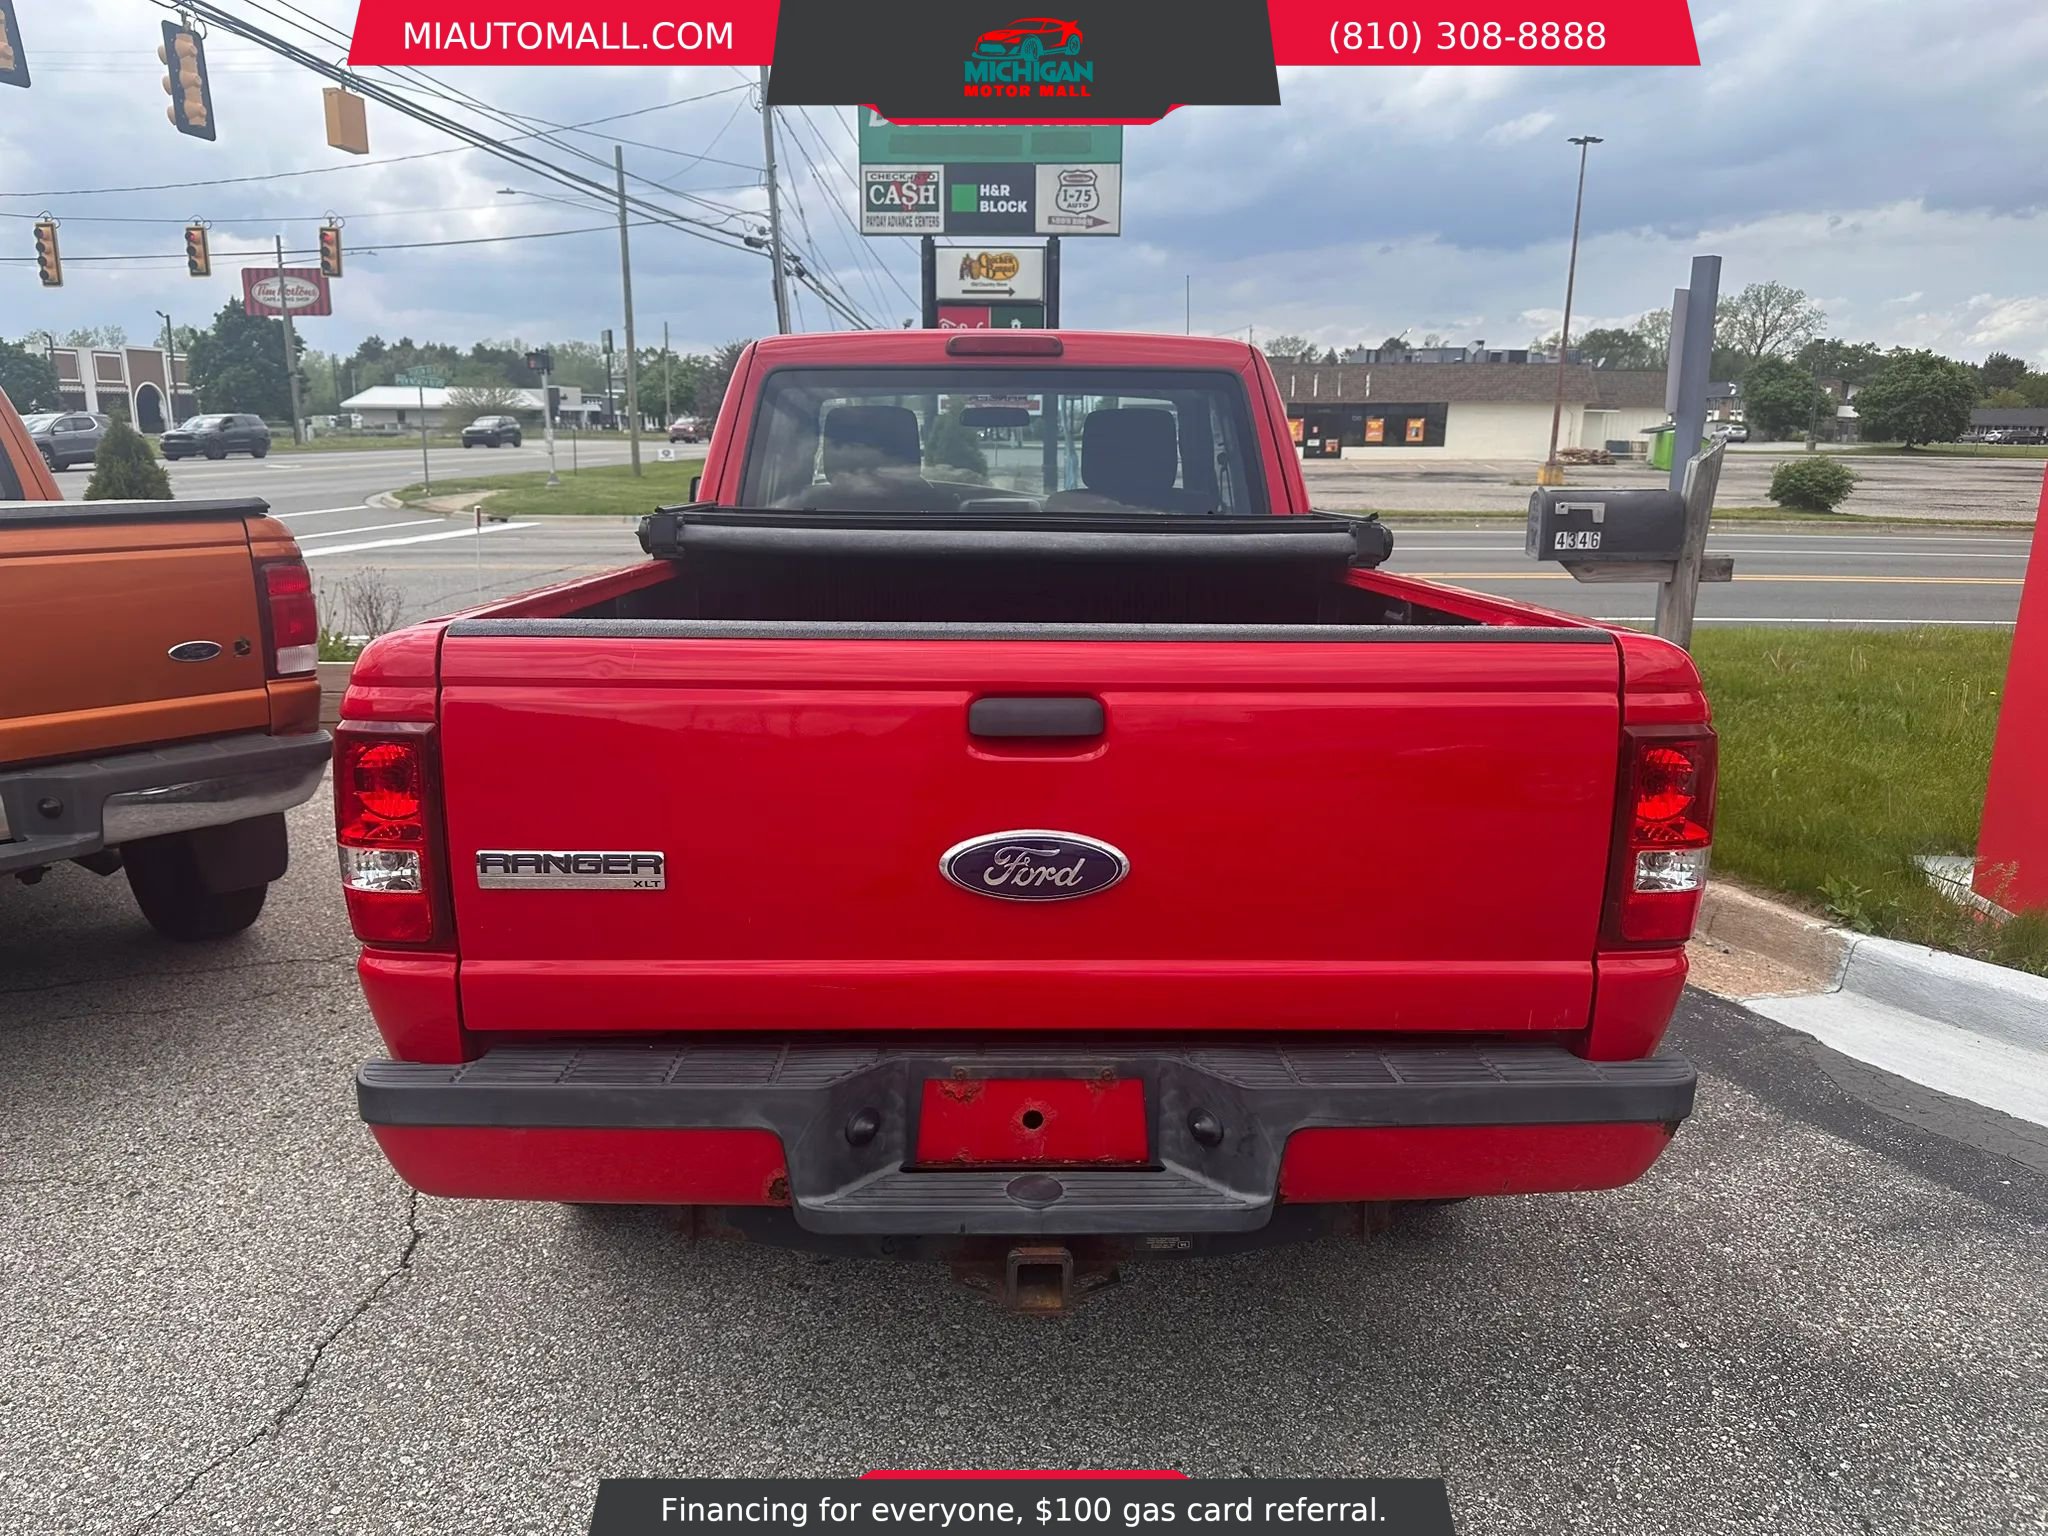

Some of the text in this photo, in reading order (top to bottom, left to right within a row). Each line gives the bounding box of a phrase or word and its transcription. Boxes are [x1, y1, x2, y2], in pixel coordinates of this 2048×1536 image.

[979, 184, 1010, 197] H&R
[1063, 189, 1092, 202] I-75
[979, 200, 1028, 213] BLOCK
[866, 216, 940, 227] PAYDAY ADVANCE CENTERS
[1557, 532, 1599, 548] 4346
[478, 853, 664, 874] RANGER
[983, 846, 1086, 886] Ford
[633, 880, 661, 888] XLT
